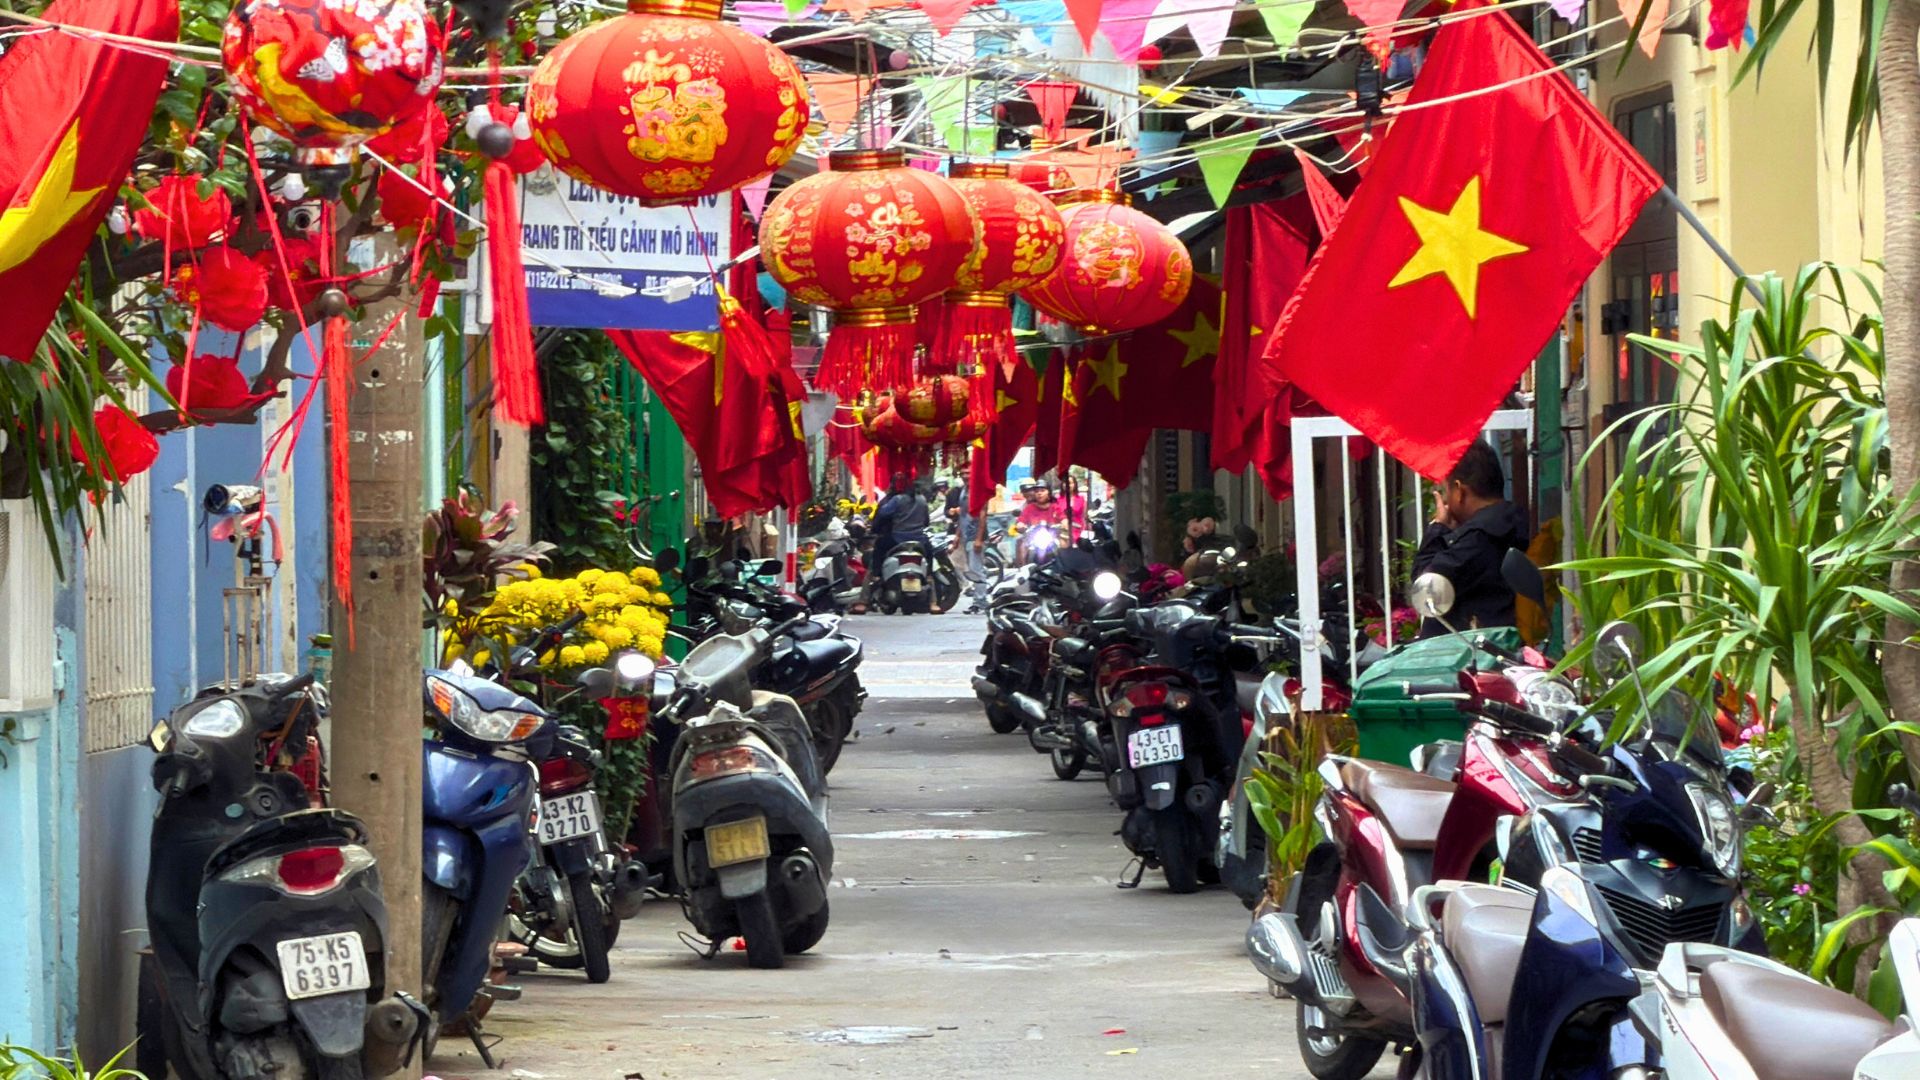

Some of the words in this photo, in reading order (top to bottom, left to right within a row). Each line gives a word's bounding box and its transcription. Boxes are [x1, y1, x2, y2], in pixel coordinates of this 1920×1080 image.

[522, 223, 560, 250] RANG
[620, 219, 658, 254] CẢNH
[661, 225, 682, 256] MÔ
[1133, 743, 1179, 766] 943.50
[544, 814, 591, 840] 9270
[296, 962, 353, 991] 6397
